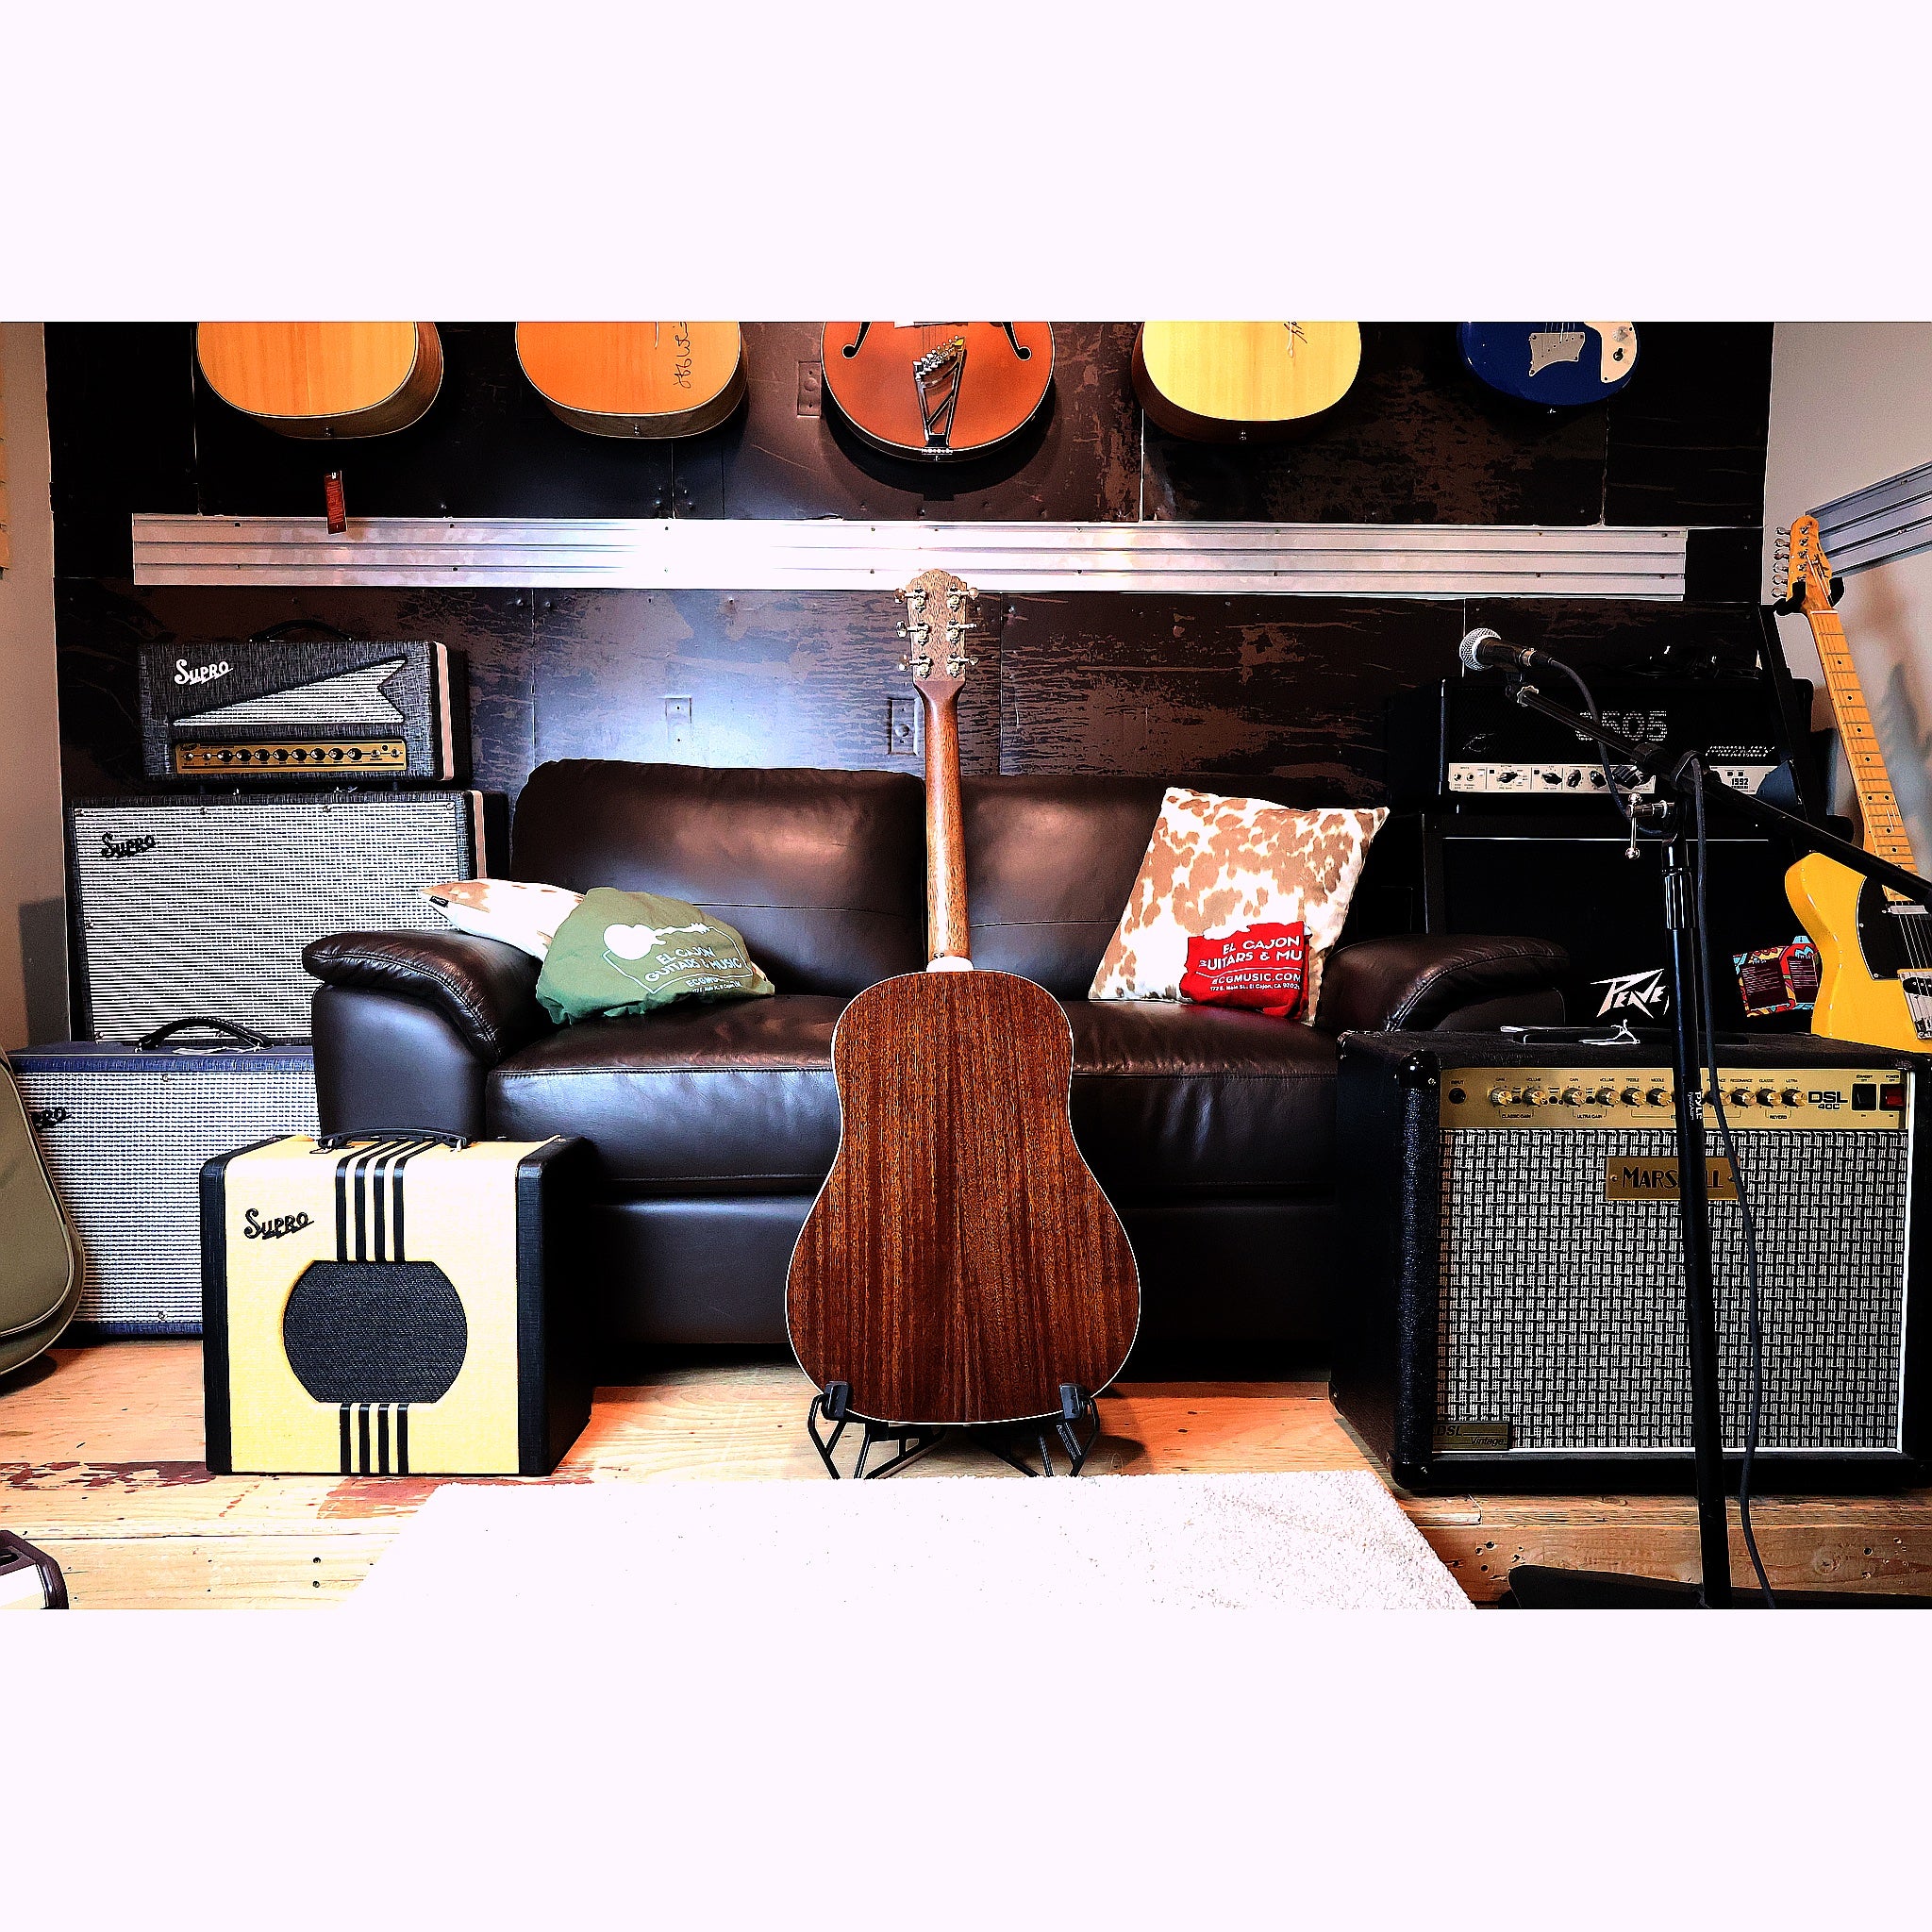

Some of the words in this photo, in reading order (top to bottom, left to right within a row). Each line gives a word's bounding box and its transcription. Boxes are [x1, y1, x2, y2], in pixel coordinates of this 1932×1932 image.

[1223, 942, 1236, 956] EL
[1242, 935, 1300, 950] CAJON
[655, 953, 676, 966] EL
[675, 946, 716, 958] CAJON
[1259, 951, 1271, 961] &
[644, 958, 701, 982] GUITARS
[708, 957, 742, 971] MUSIC
[1807, 1091, 1849, 1104] DSL
[1622, 1166, 1724, 1189] MARSLL
